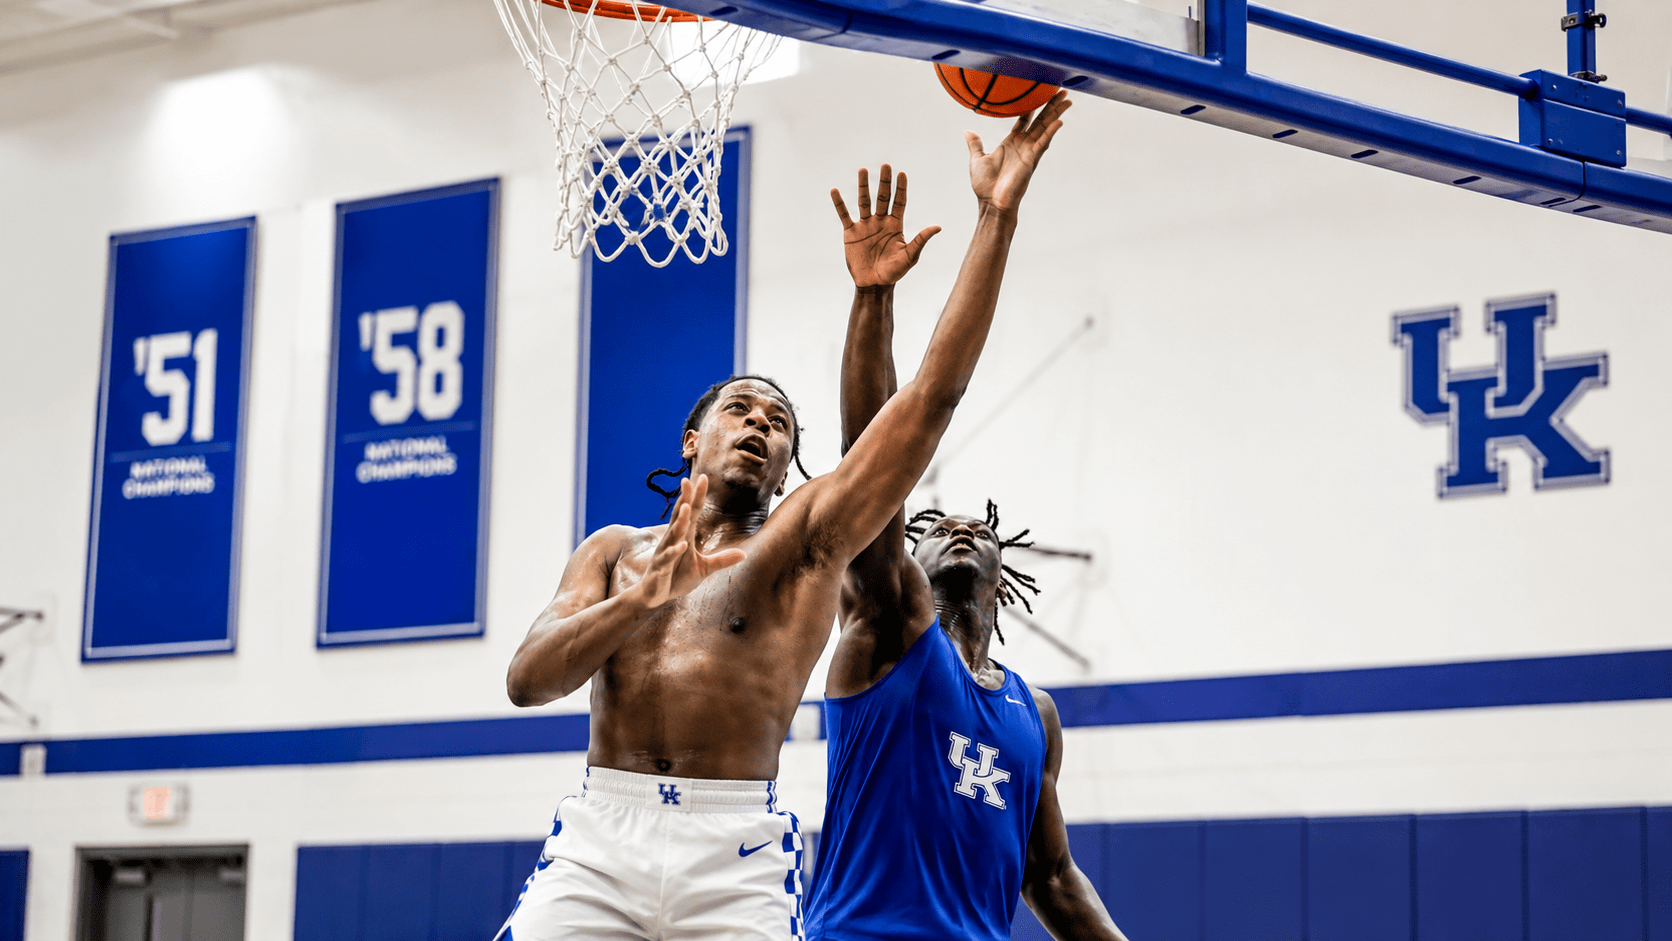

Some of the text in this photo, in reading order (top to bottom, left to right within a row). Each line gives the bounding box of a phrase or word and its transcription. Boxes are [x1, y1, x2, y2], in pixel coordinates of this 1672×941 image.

[358, 301, 465, 425] '58
[133, 328, 218, 446] '51
[1390, 291, 1610, 500] UK
[364, 435, 449, 460] NATIONAL
[130, 455, 208, 479] NATIONAL
[355, 452, 458, 484] CHAMPIONS
[122, 472, 215, 499] CHAMPIONS
[948, 731, 1011, 809] UK
[658, 783, 681, 805] UK
